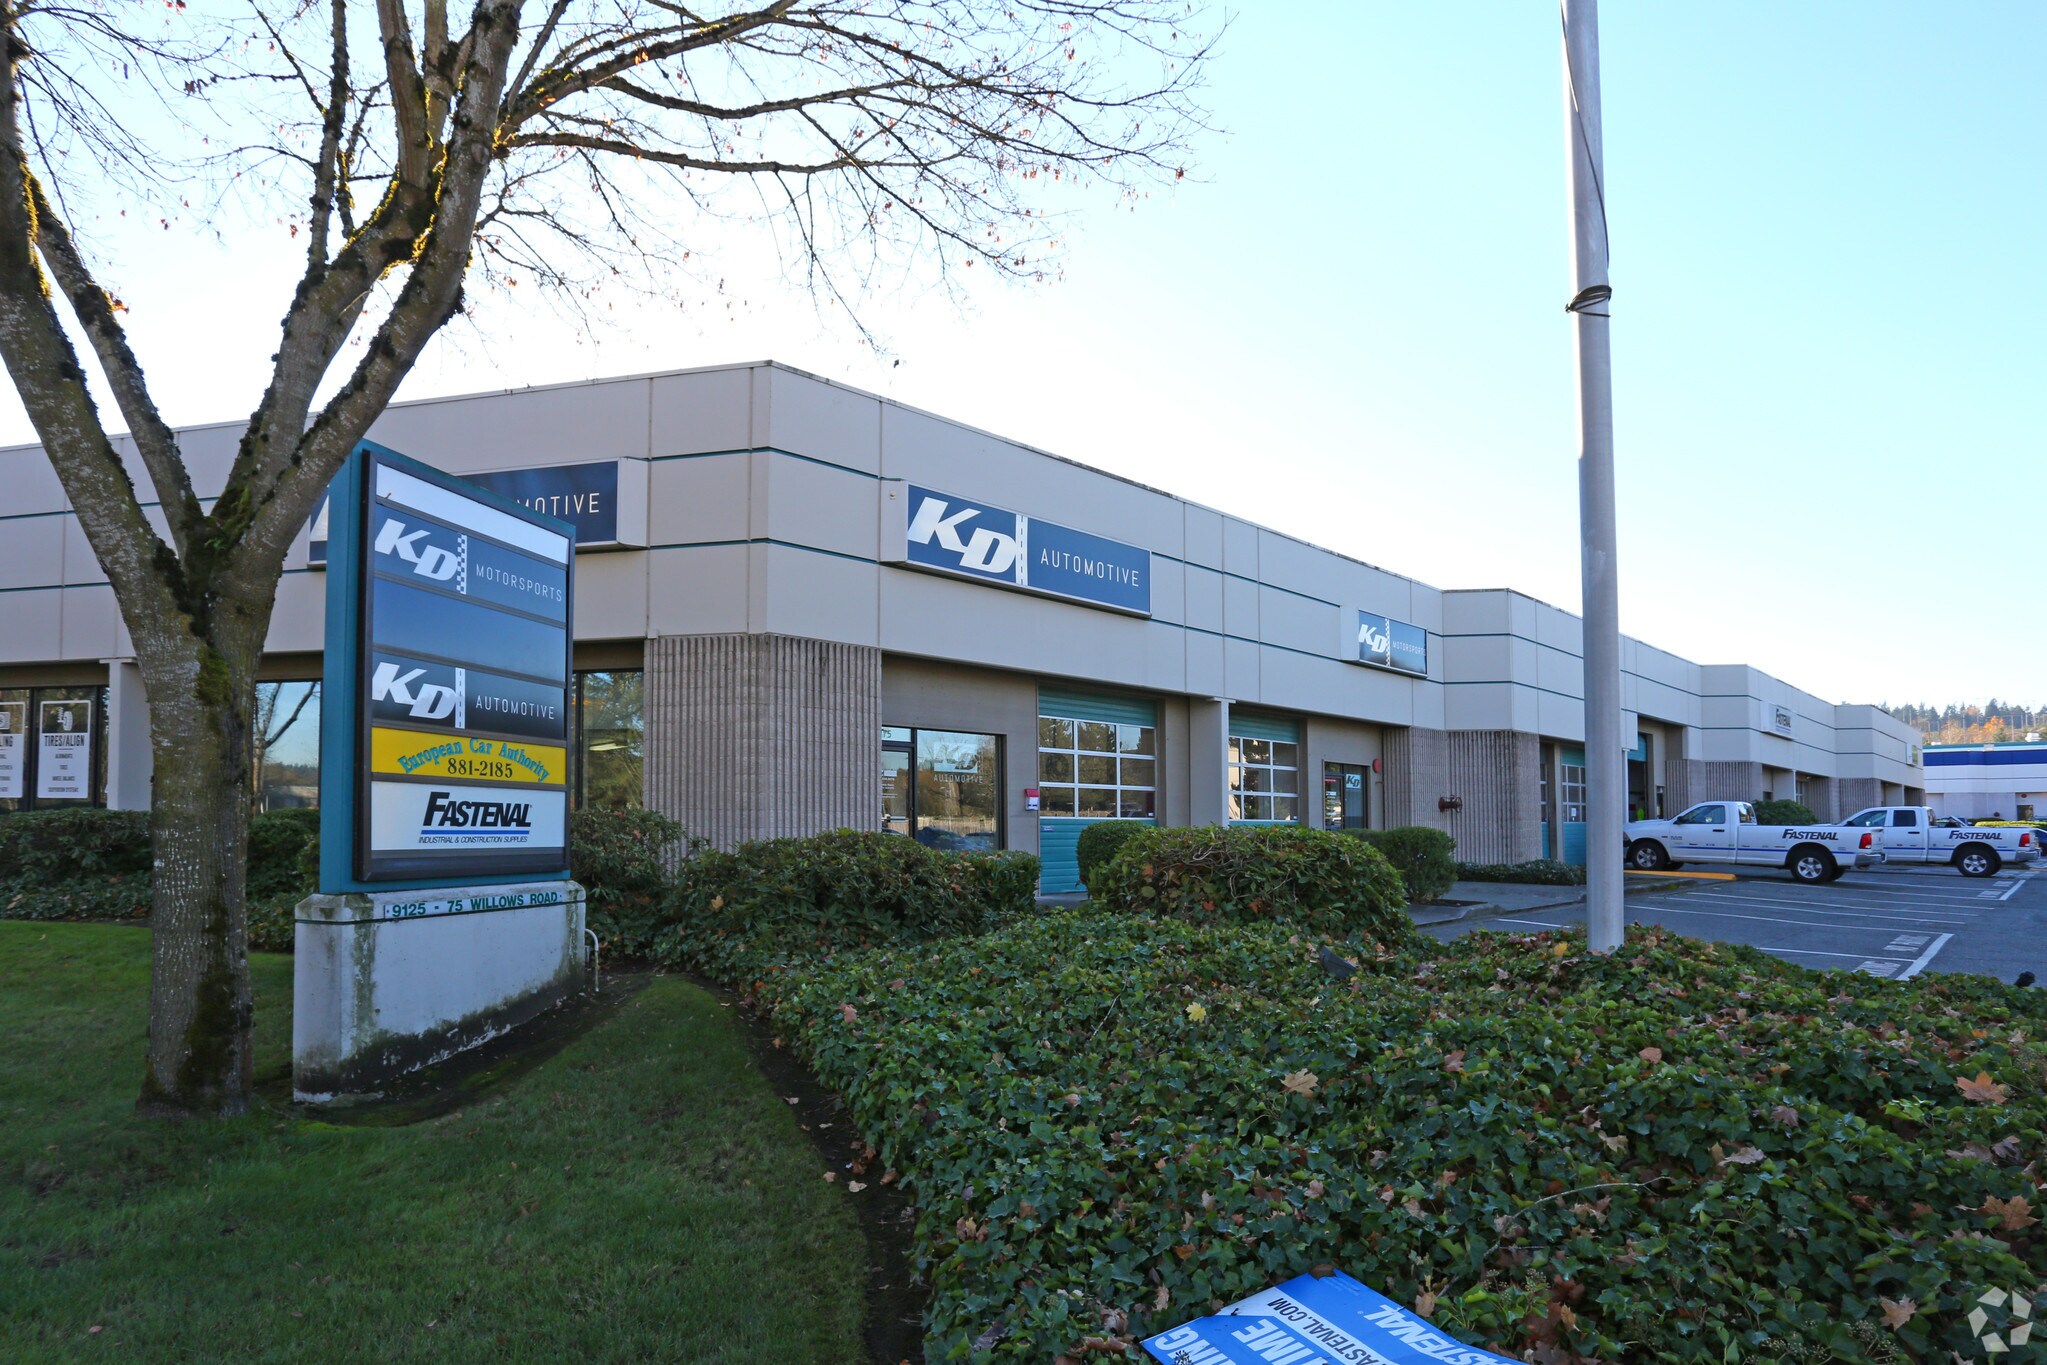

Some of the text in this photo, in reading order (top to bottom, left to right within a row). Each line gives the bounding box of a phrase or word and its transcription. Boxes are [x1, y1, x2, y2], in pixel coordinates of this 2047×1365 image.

[907, 496, 1017, 573] KD
[374, 518, 459, 581] KD
[1040, 548, 1140, 587] AUTOMOTIVE
[476, 563, 562, 602] MOTORSPORTS
[1359, 623, 1387, 653] KD
[372, 661, 456, 719] KD
[475, 695, 555, 720] AUTOMOTIVE
[44, 735, 85, 747] TIRES/ALIGN
[398, 737, 550, 783] European Car Authority
[447, 758, 513, 778] 881-2185
[934, 774, 984, 784] AUTOMOTIVE
[1346, 775, 1361, 787] KD
[422, 791, 532, 828] FASTENAL
[418, 836, 454, 844] INDUSTRIAL
[460, 836, 502, 844] CONSTRUCTION
[1782, 829, 1839, 841] FASTENAL
[1949, 830, 2003, 841] FASTENAL
[392, 902, 426, 917] 9125
[447, 900, 463, 913] 75
[470, 894, 524, 910] WILLOWS
[530, 891, 558, 905] ROAD
[1267, 1297, 1386, 1365] ASTENAL.COM
